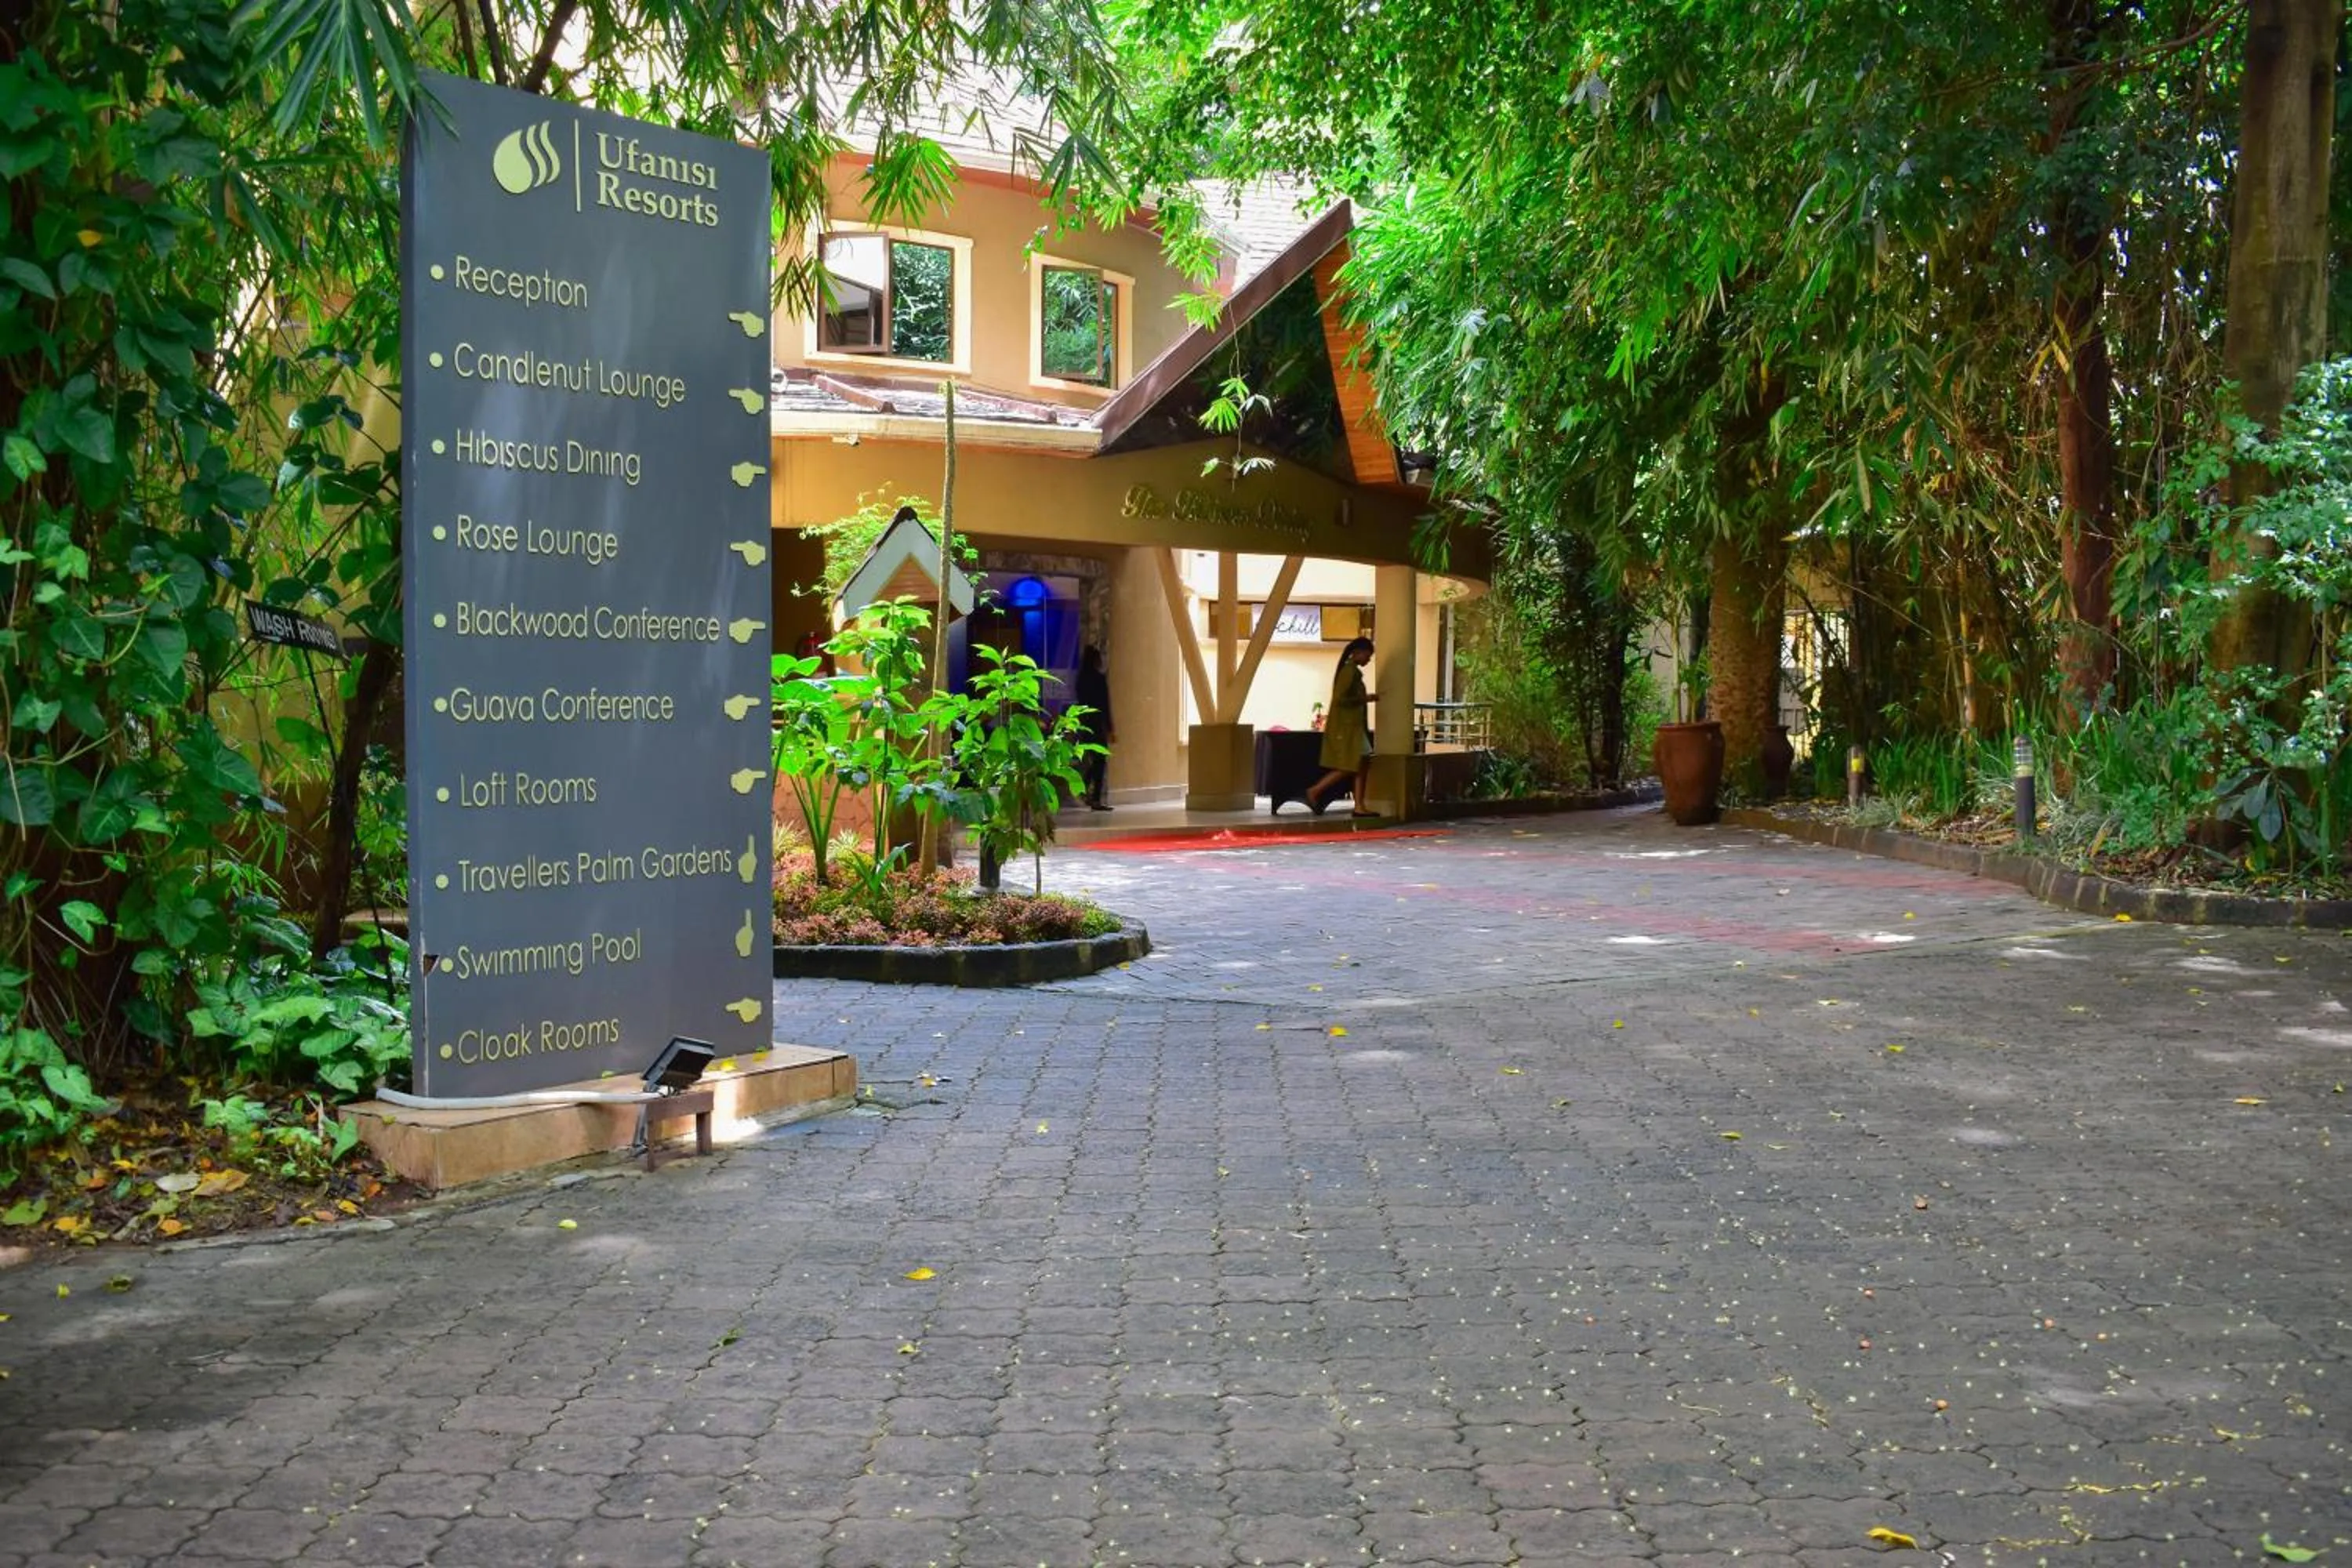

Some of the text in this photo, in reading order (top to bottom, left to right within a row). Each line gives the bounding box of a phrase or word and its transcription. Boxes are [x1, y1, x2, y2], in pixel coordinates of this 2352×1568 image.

[598, 132, 717, 190] Ufanisi
[597, 171, 719, 227] Resorts
[456, 256, 587, 308] Reception
[454, 342, 685, 408] Candlenut Lounge
[456, 428, 641, 485] Hibiscus Dining
[456, 514, 619, 564] Rose Lounge
[249, 605, 296, 640] WASH
[456, 602, 720, 641] Blackwood Conference
[450, 688, 674, 721] Guava Conference
[460, 772, 597, 808] Loft Rooms
[458, 845, 731, 892] Travellers Palm Gardens
[456, 929, 641, 979] Swimming Pool
[457, 1017, 620, 1065] Cloak Rooms
